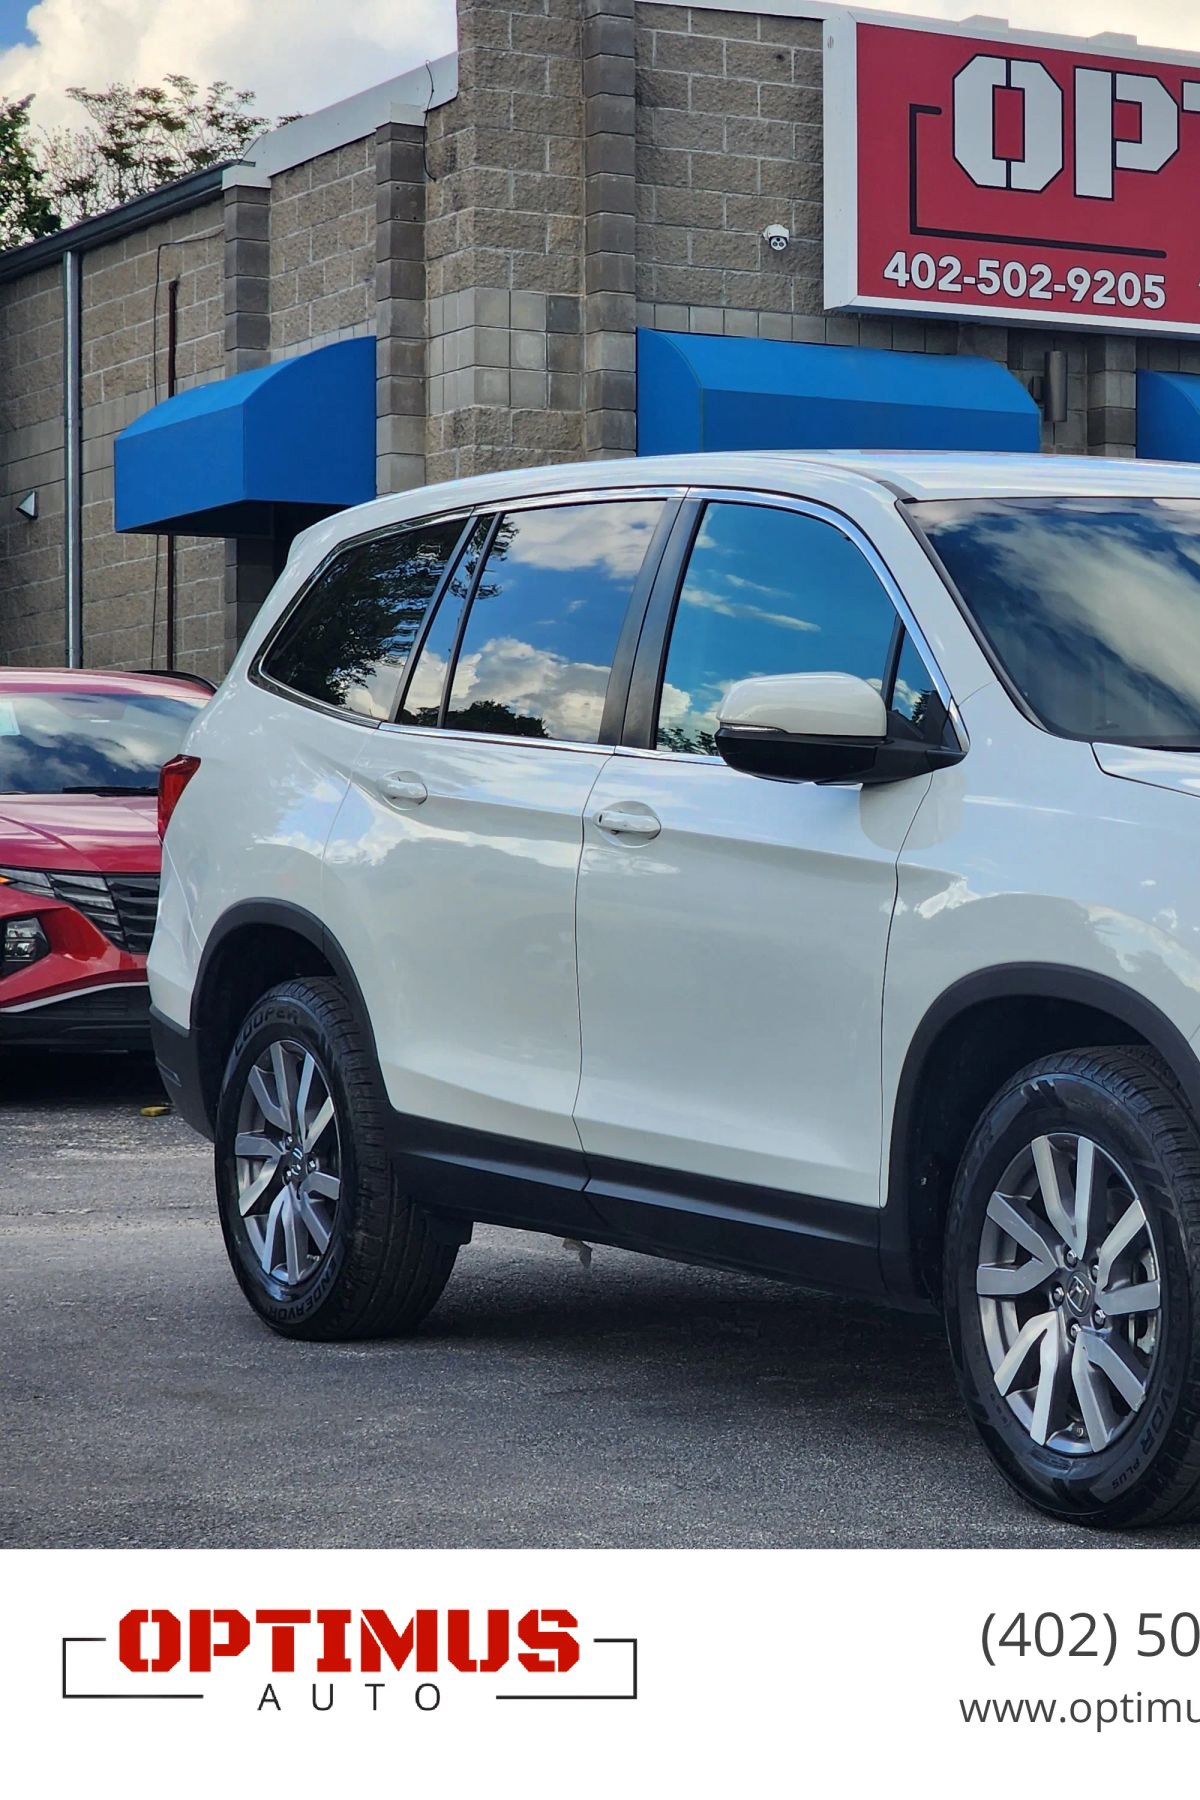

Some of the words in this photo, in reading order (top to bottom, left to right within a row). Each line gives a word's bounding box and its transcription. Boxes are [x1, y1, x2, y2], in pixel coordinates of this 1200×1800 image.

[883, 251, 1167, 310] 402-502-9205
[234, 1007, 298, 1057] COOPER
[1111, 1458, 1141, 1490] PLUS
